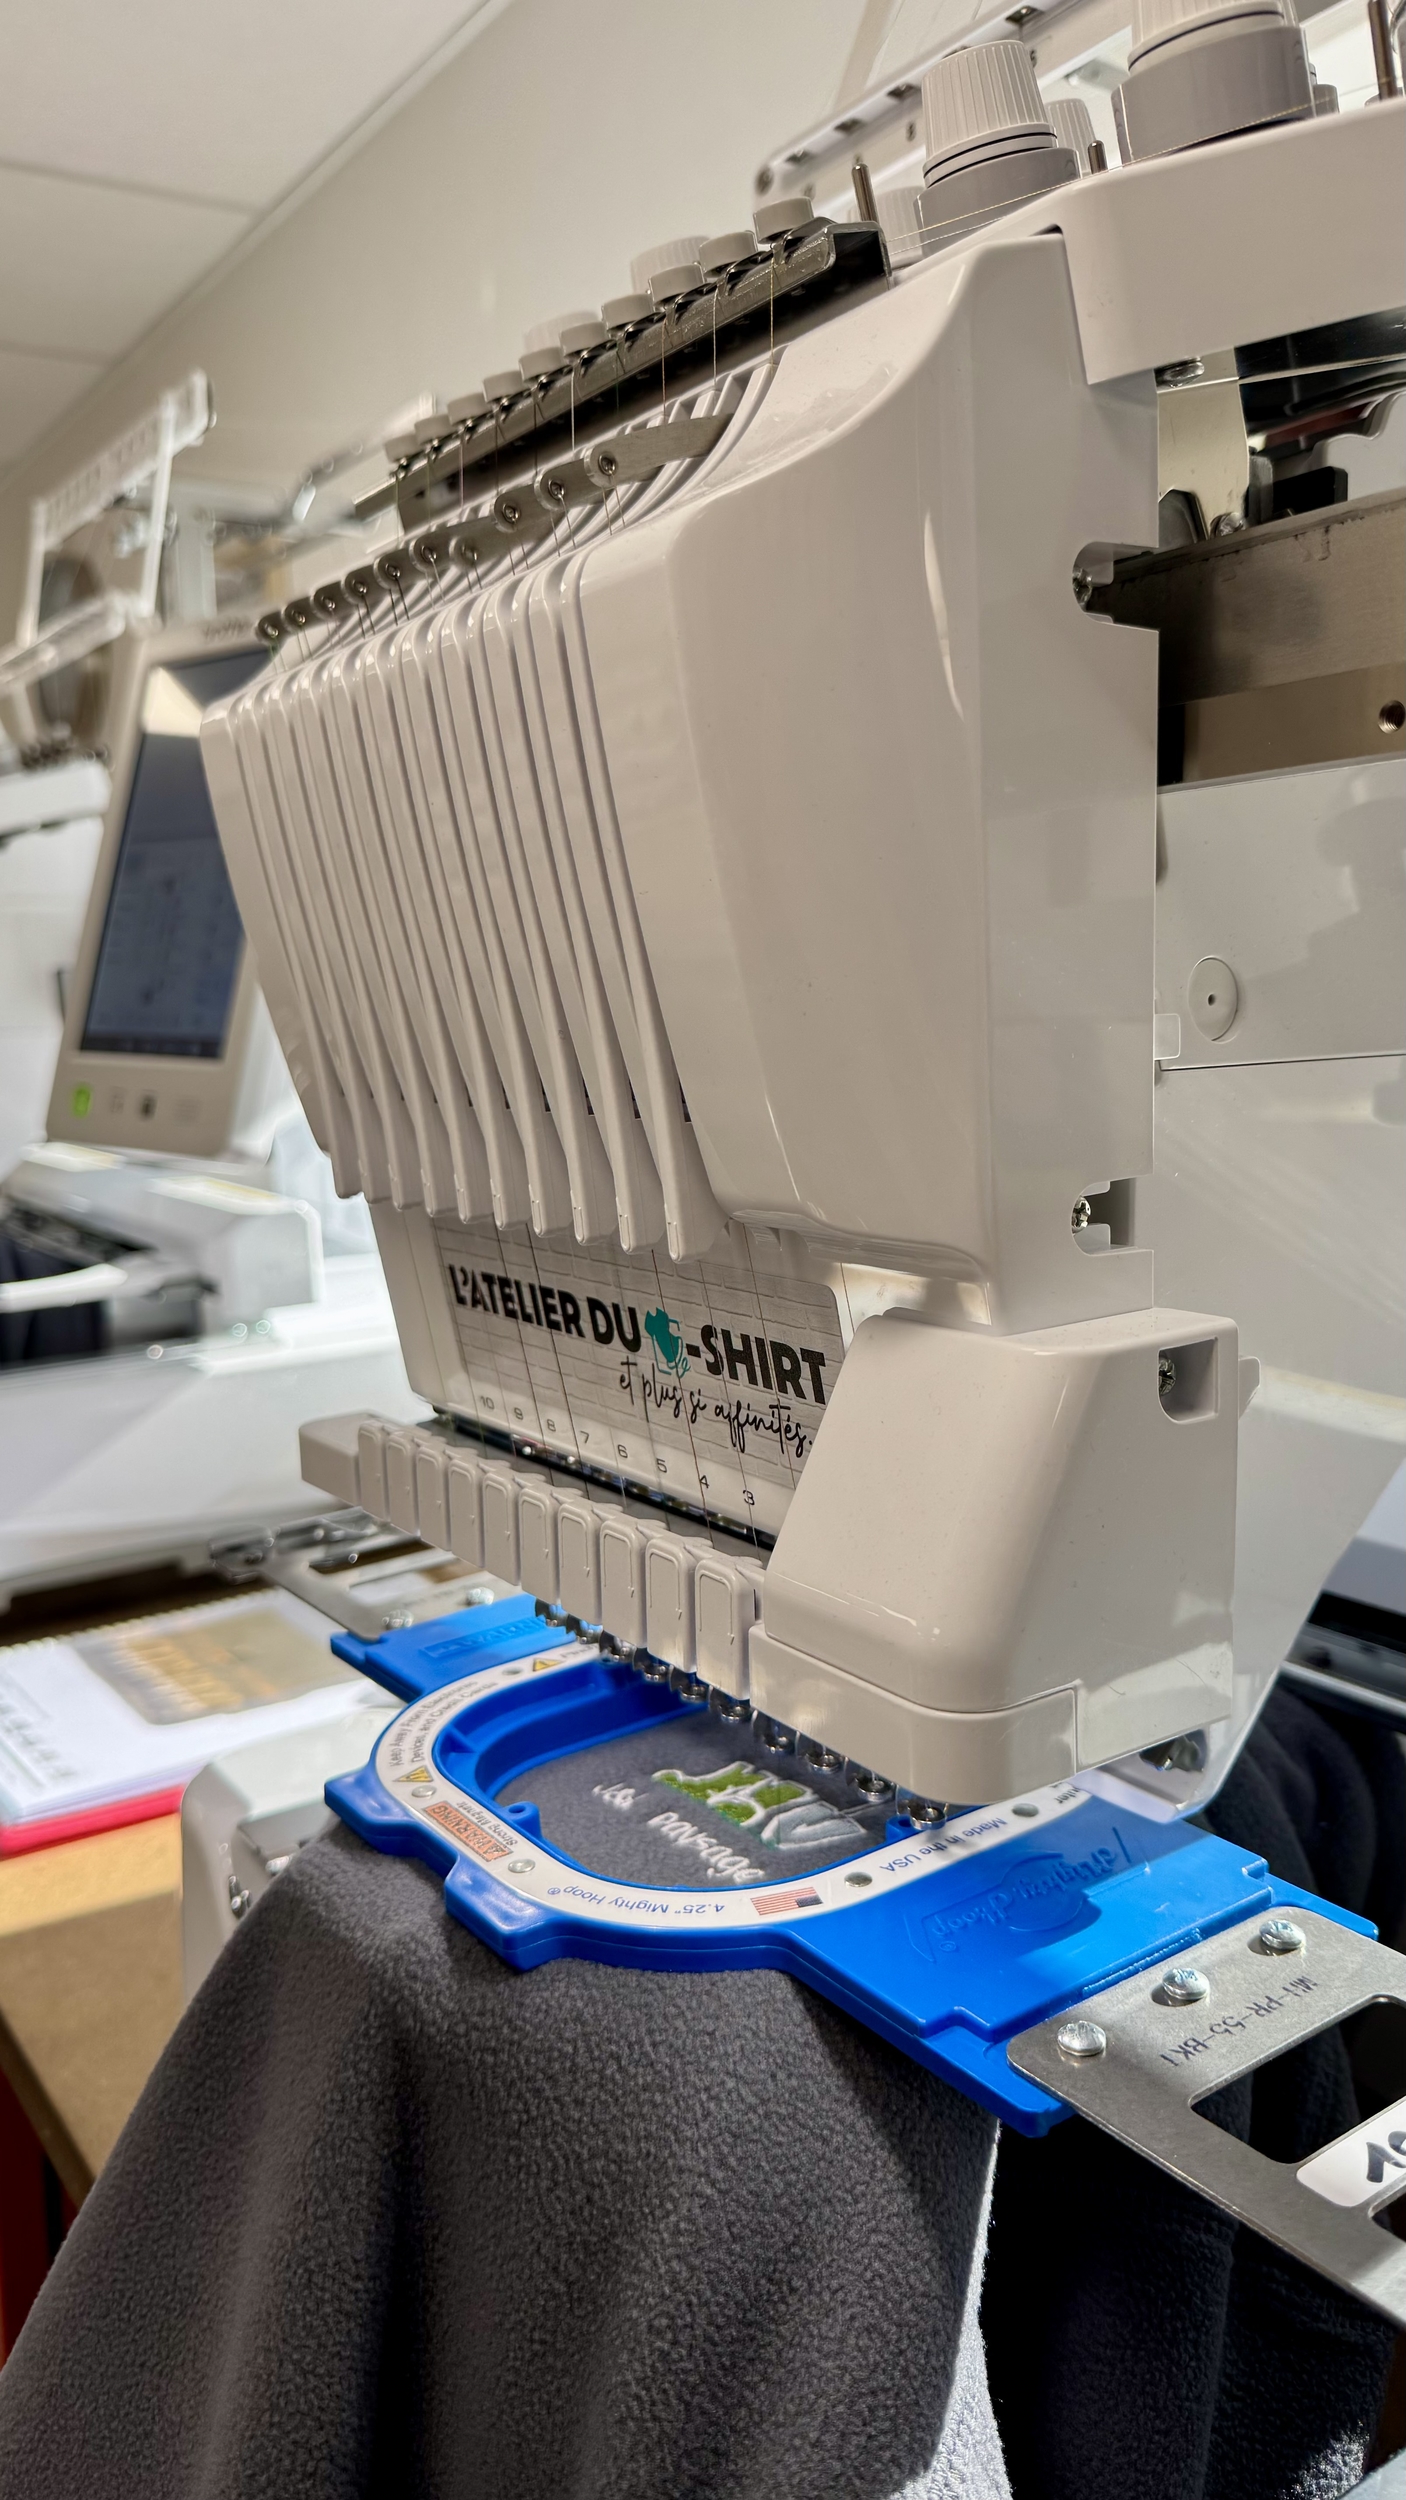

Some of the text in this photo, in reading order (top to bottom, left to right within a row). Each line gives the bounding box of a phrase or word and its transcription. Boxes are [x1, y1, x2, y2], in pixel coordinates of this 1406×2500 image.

[449, 1264, 585, 1338] L'ATELIER
[586, 1296, 642, 1353] DU
[620, 1356, 637, 1405] et
[642, 1364, 683, 1420] plus
[689, 1388, 707, 1423] si
[480, 1396, 755, 1506] 10 9 8 7 6 5 4 3
[432, 1805, 492, 1849] WARNING
[879, 1817, 1008, 1873] Made in the USA
[607, 1895, 670, 1916] Mighty
